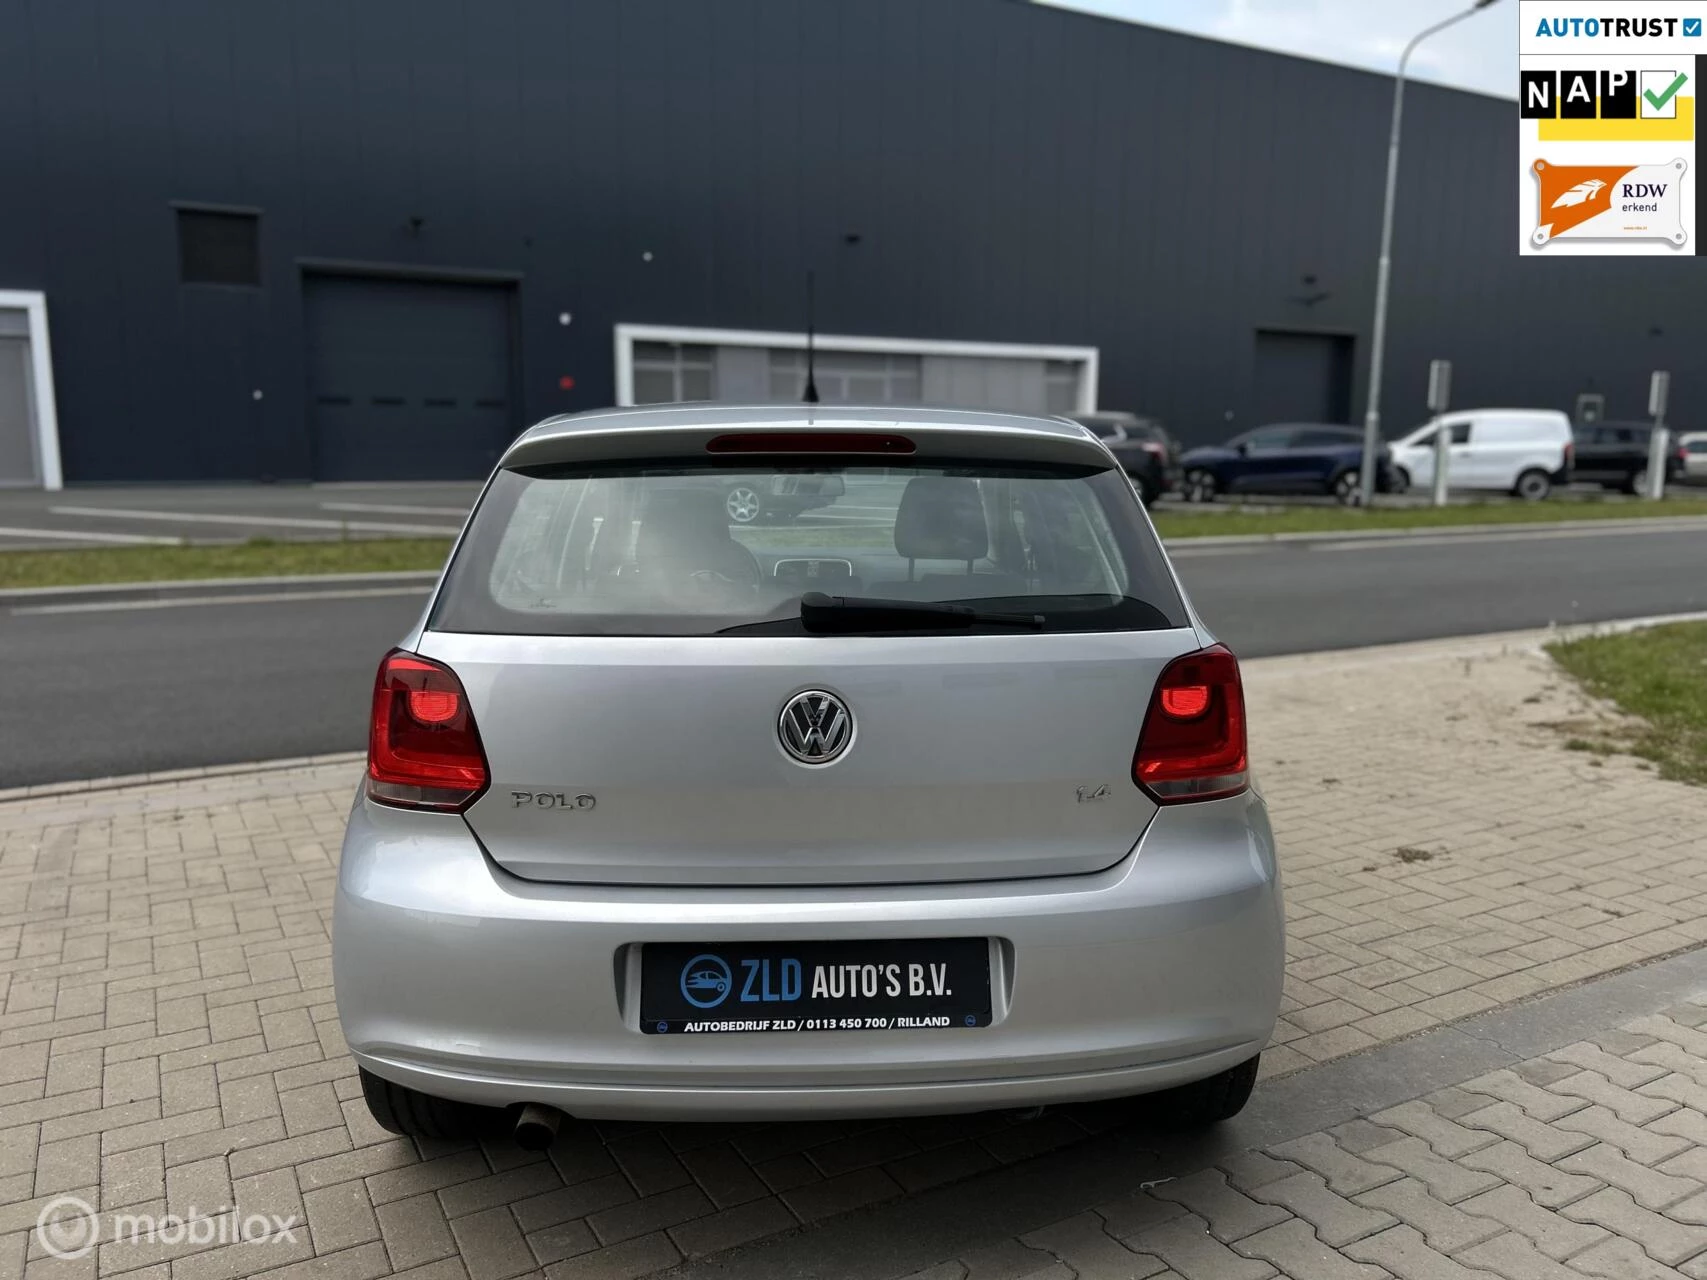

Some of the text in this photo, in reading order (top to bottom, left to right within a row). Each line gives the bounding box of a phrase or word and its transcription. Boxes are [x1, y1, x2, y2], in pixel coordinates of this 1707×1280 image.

[782, 692, 849, 760] VW
[511, 791, 596, 810] POLO
[740, 958, 952, 1002] ZLD AUTO'S B.V.
[684, 1020, 770, 1033] AUTOBEDRIJF
[772, 1020, 797, 1030] ZLD
[806, 1018, 837, 1029] 0113
[839, 1018, 862, 1028] 450
[864, 1017, 887, 1028] 700
[897, 1016, 950, 1028] RILLAND
